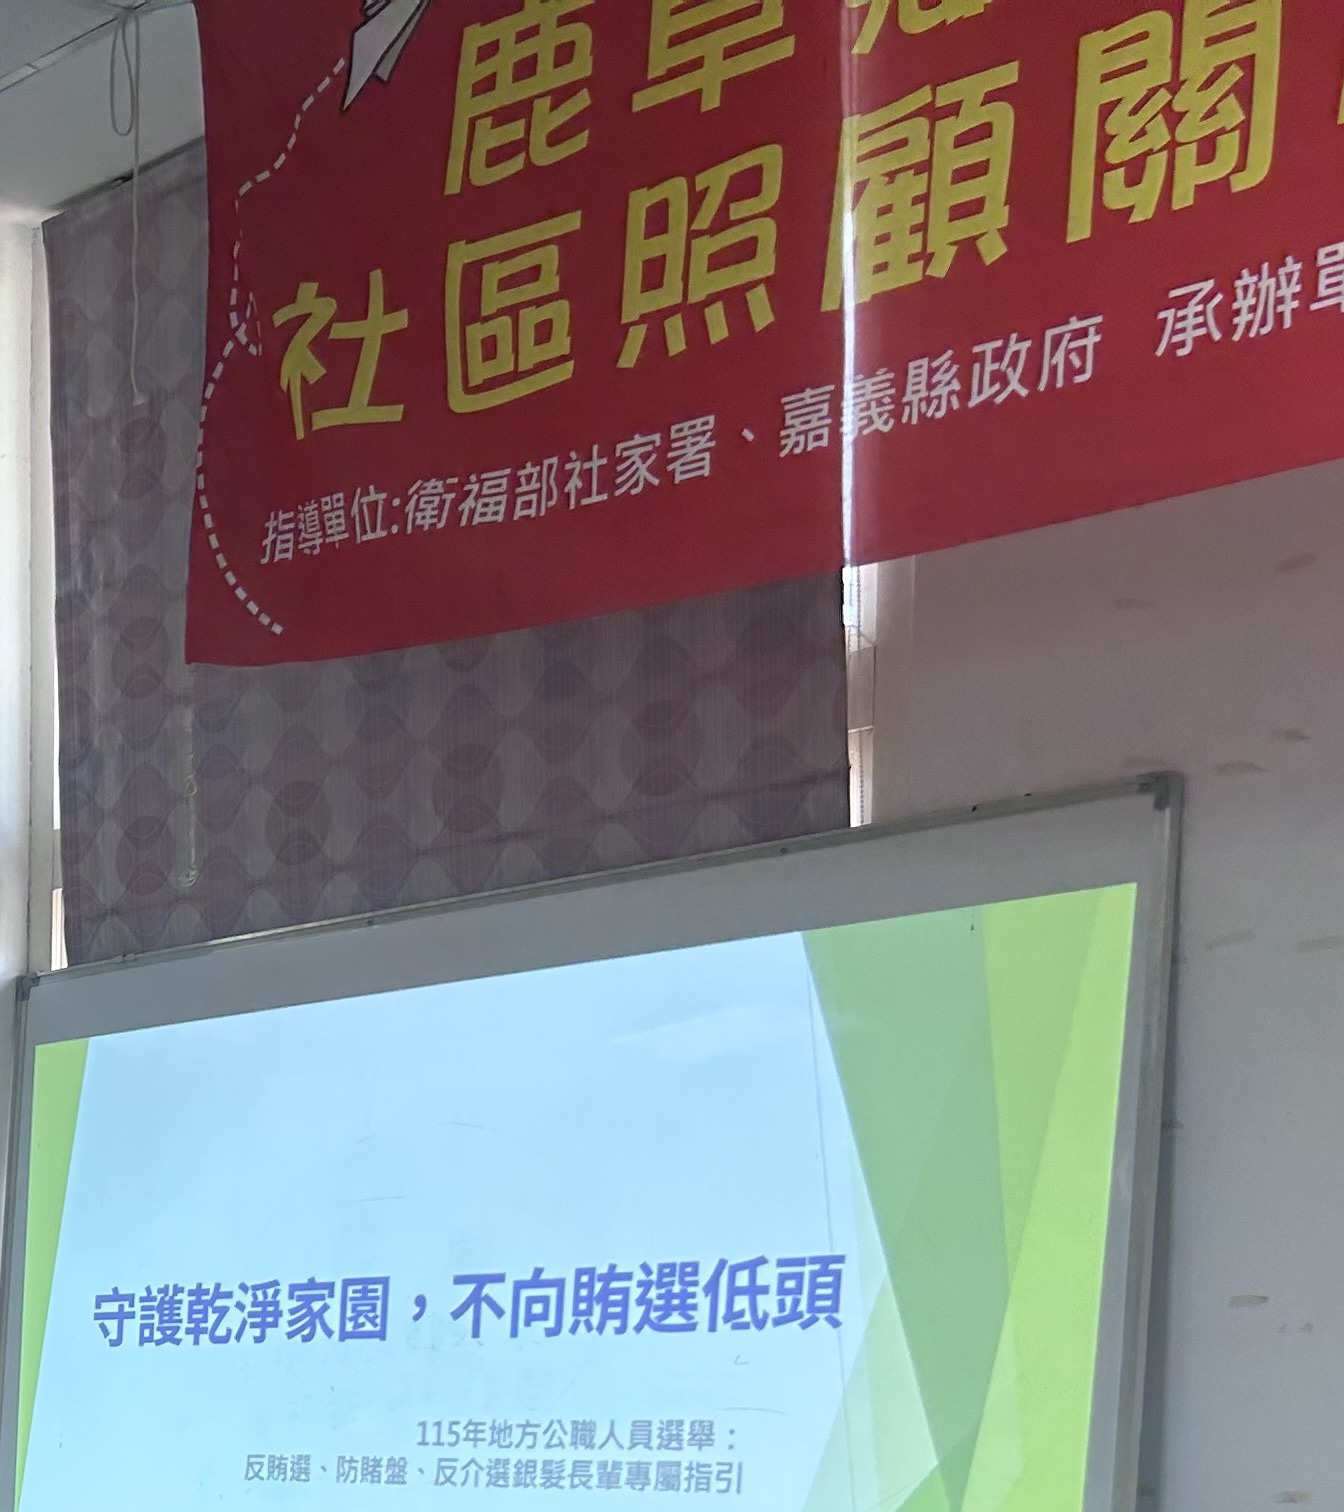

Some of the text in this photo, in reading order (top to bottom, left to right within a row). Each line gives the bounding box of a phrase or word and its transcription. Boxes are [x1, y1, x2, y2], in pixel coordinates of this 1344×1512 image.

[444, 0, 991, 196] 鹿草
[271, 0, 1344, 439] 社區照顧關
[93, 1254, 847, 1348] 守護乾淨家園，不向賄選低頭
[416, 1419, 737, 1452] 115年地方公職人員選舉：
